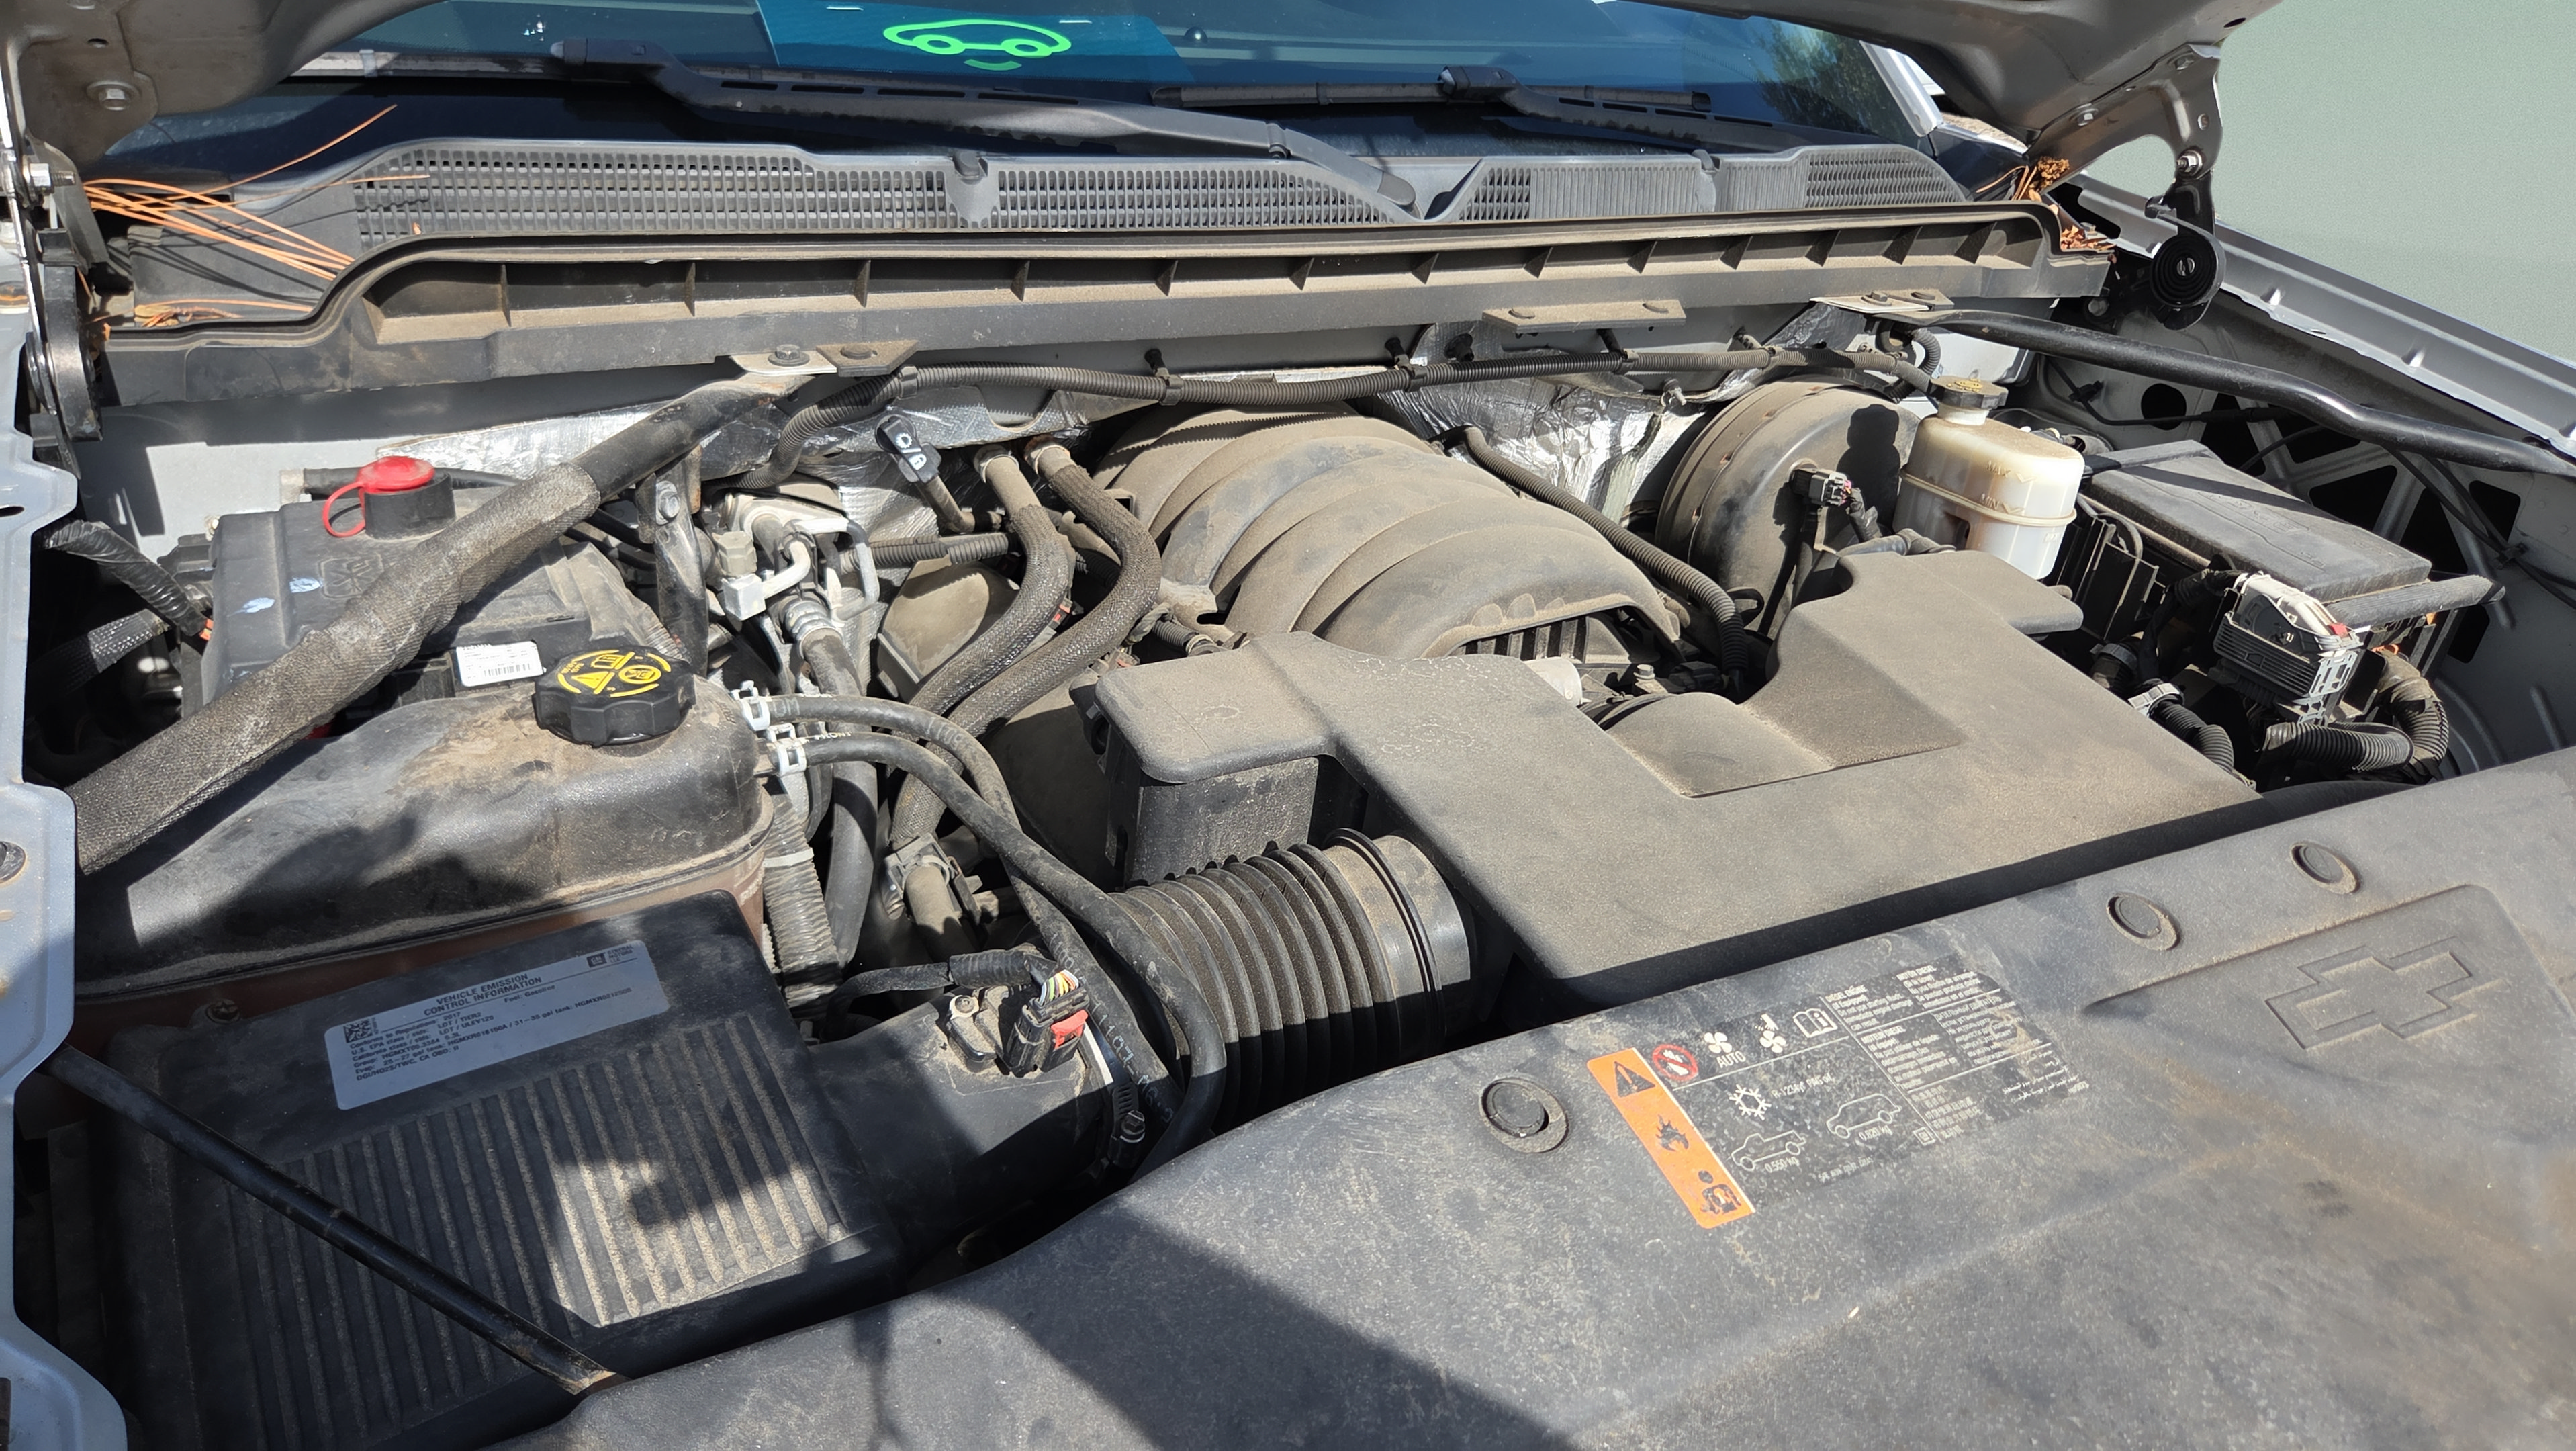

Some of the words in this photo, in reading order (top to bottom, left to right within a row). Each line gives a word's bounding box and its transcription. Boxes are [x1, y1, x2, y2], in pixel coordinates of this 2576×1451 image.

[1986, 460, 2011, 478] MAX
[1980, 493, 2000, 511] MIN
[424, 999, 471, 1016] CONTROL
[473, 976, 542, 1002] INFORMATION
[436, 987, 478, 1005] VEHICLE
[481, 973, 528, 992] EMISSION
[369, 1042, 384, 1050] EPA
[1716, 1051, 1746, 1069] AUTO
[1764, 1159, 1787, 1173] 0.550
